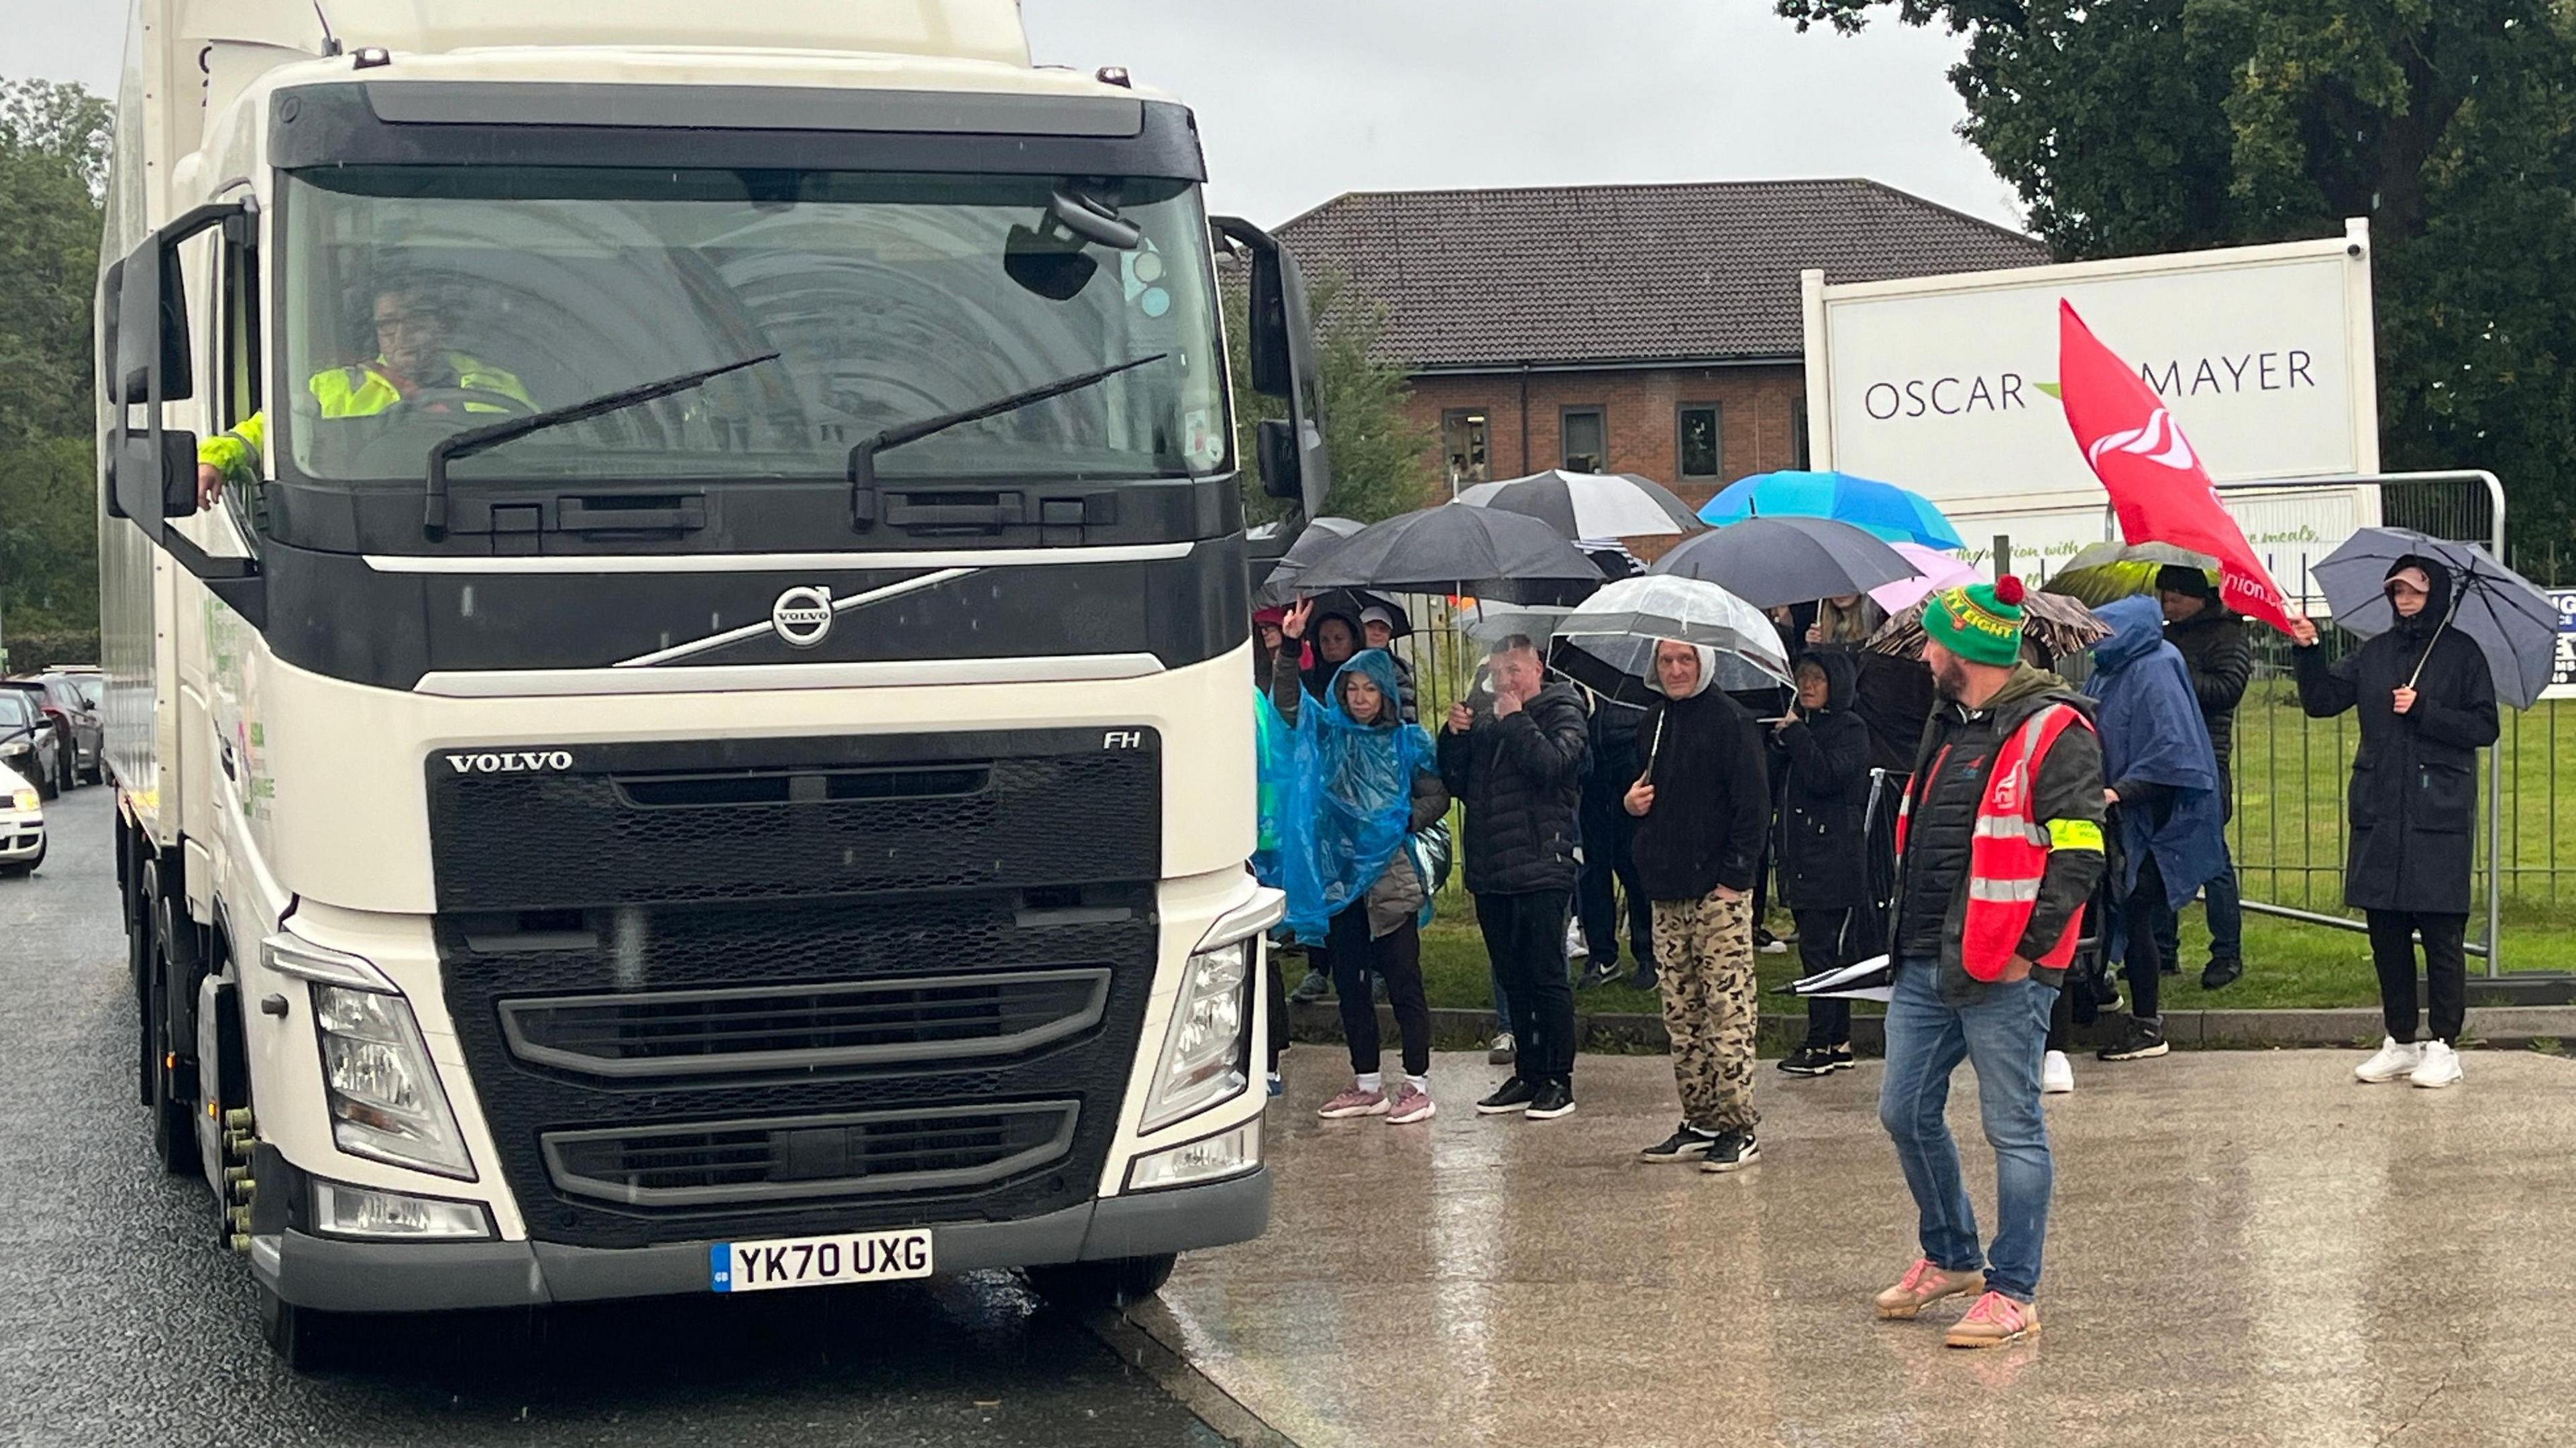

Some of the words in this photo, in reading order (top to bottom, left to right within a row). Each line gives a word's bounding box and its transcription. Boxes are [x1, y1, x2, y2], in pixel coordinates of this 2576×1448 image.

[1865, 373, 2025, 419] OSCAR
[2142, 350, 2314, 396] MAYER
[2044, 540, 2078, 556] with
[776, 612, 829, 620] VOLVO
[1962, 608, 2012, 638] EIGHT
[1104, 732, 1140, 749] FH
[445, 751, 572, 773] VOLVO
[739, 1243, 839, 1283] YK70
[853, 1236, 926, 1274] UXG
